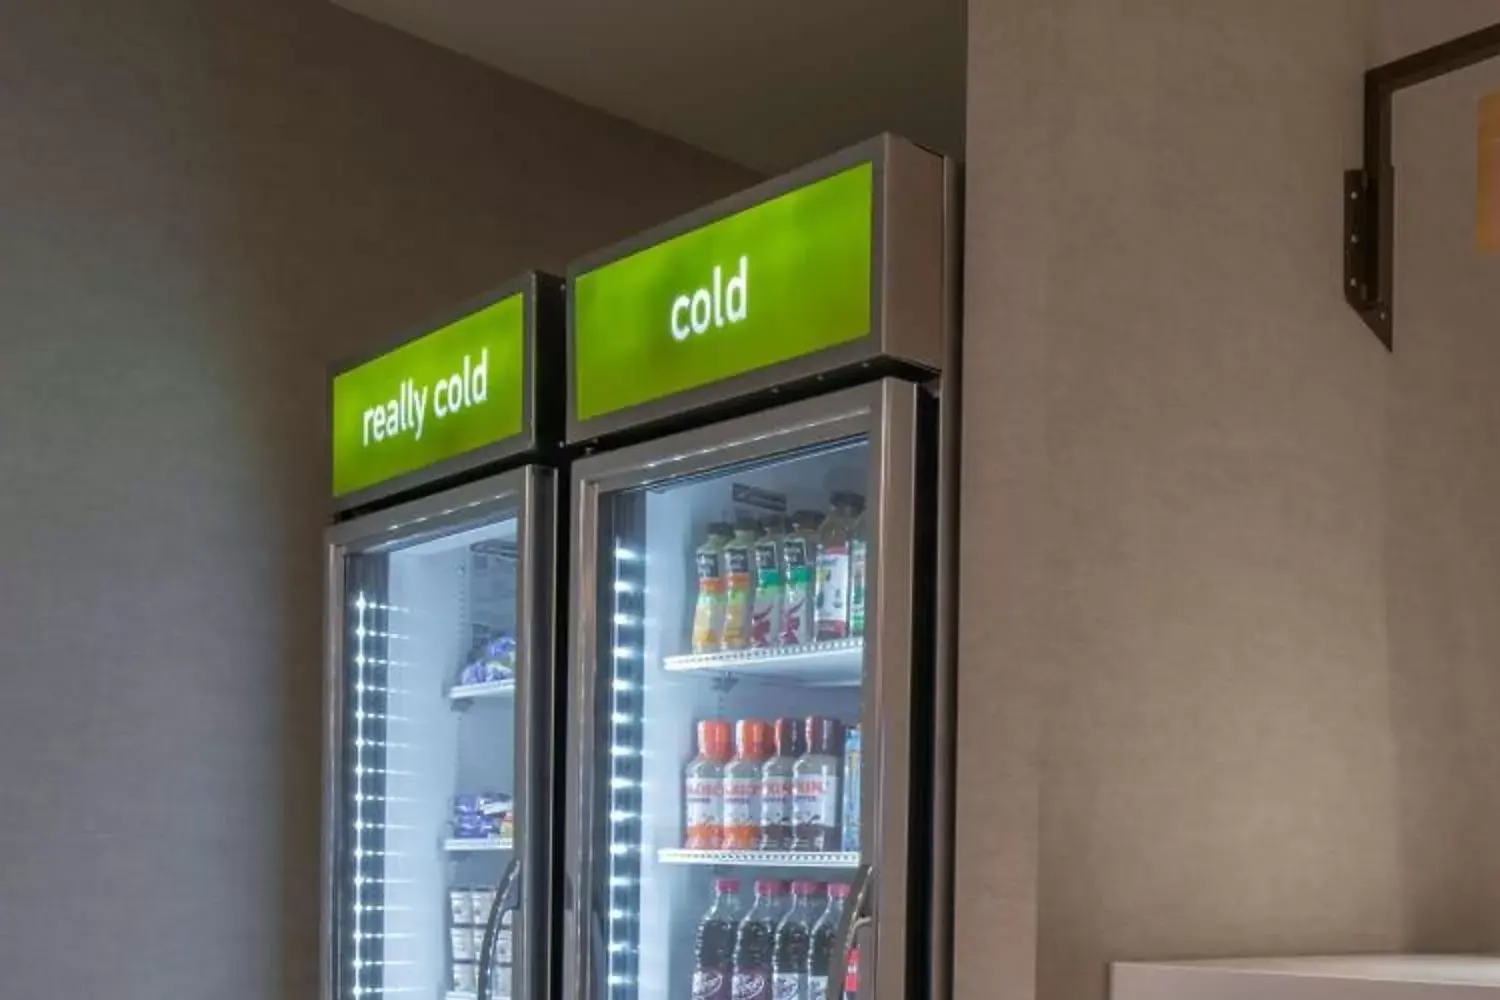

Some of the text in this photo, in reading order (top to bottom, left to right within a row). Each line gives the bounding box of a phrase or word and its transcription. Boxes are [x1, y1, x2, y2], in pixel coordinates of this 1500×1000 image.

[671, 254, 748, 341] cold
[362, 346, 489, 447] really cold
